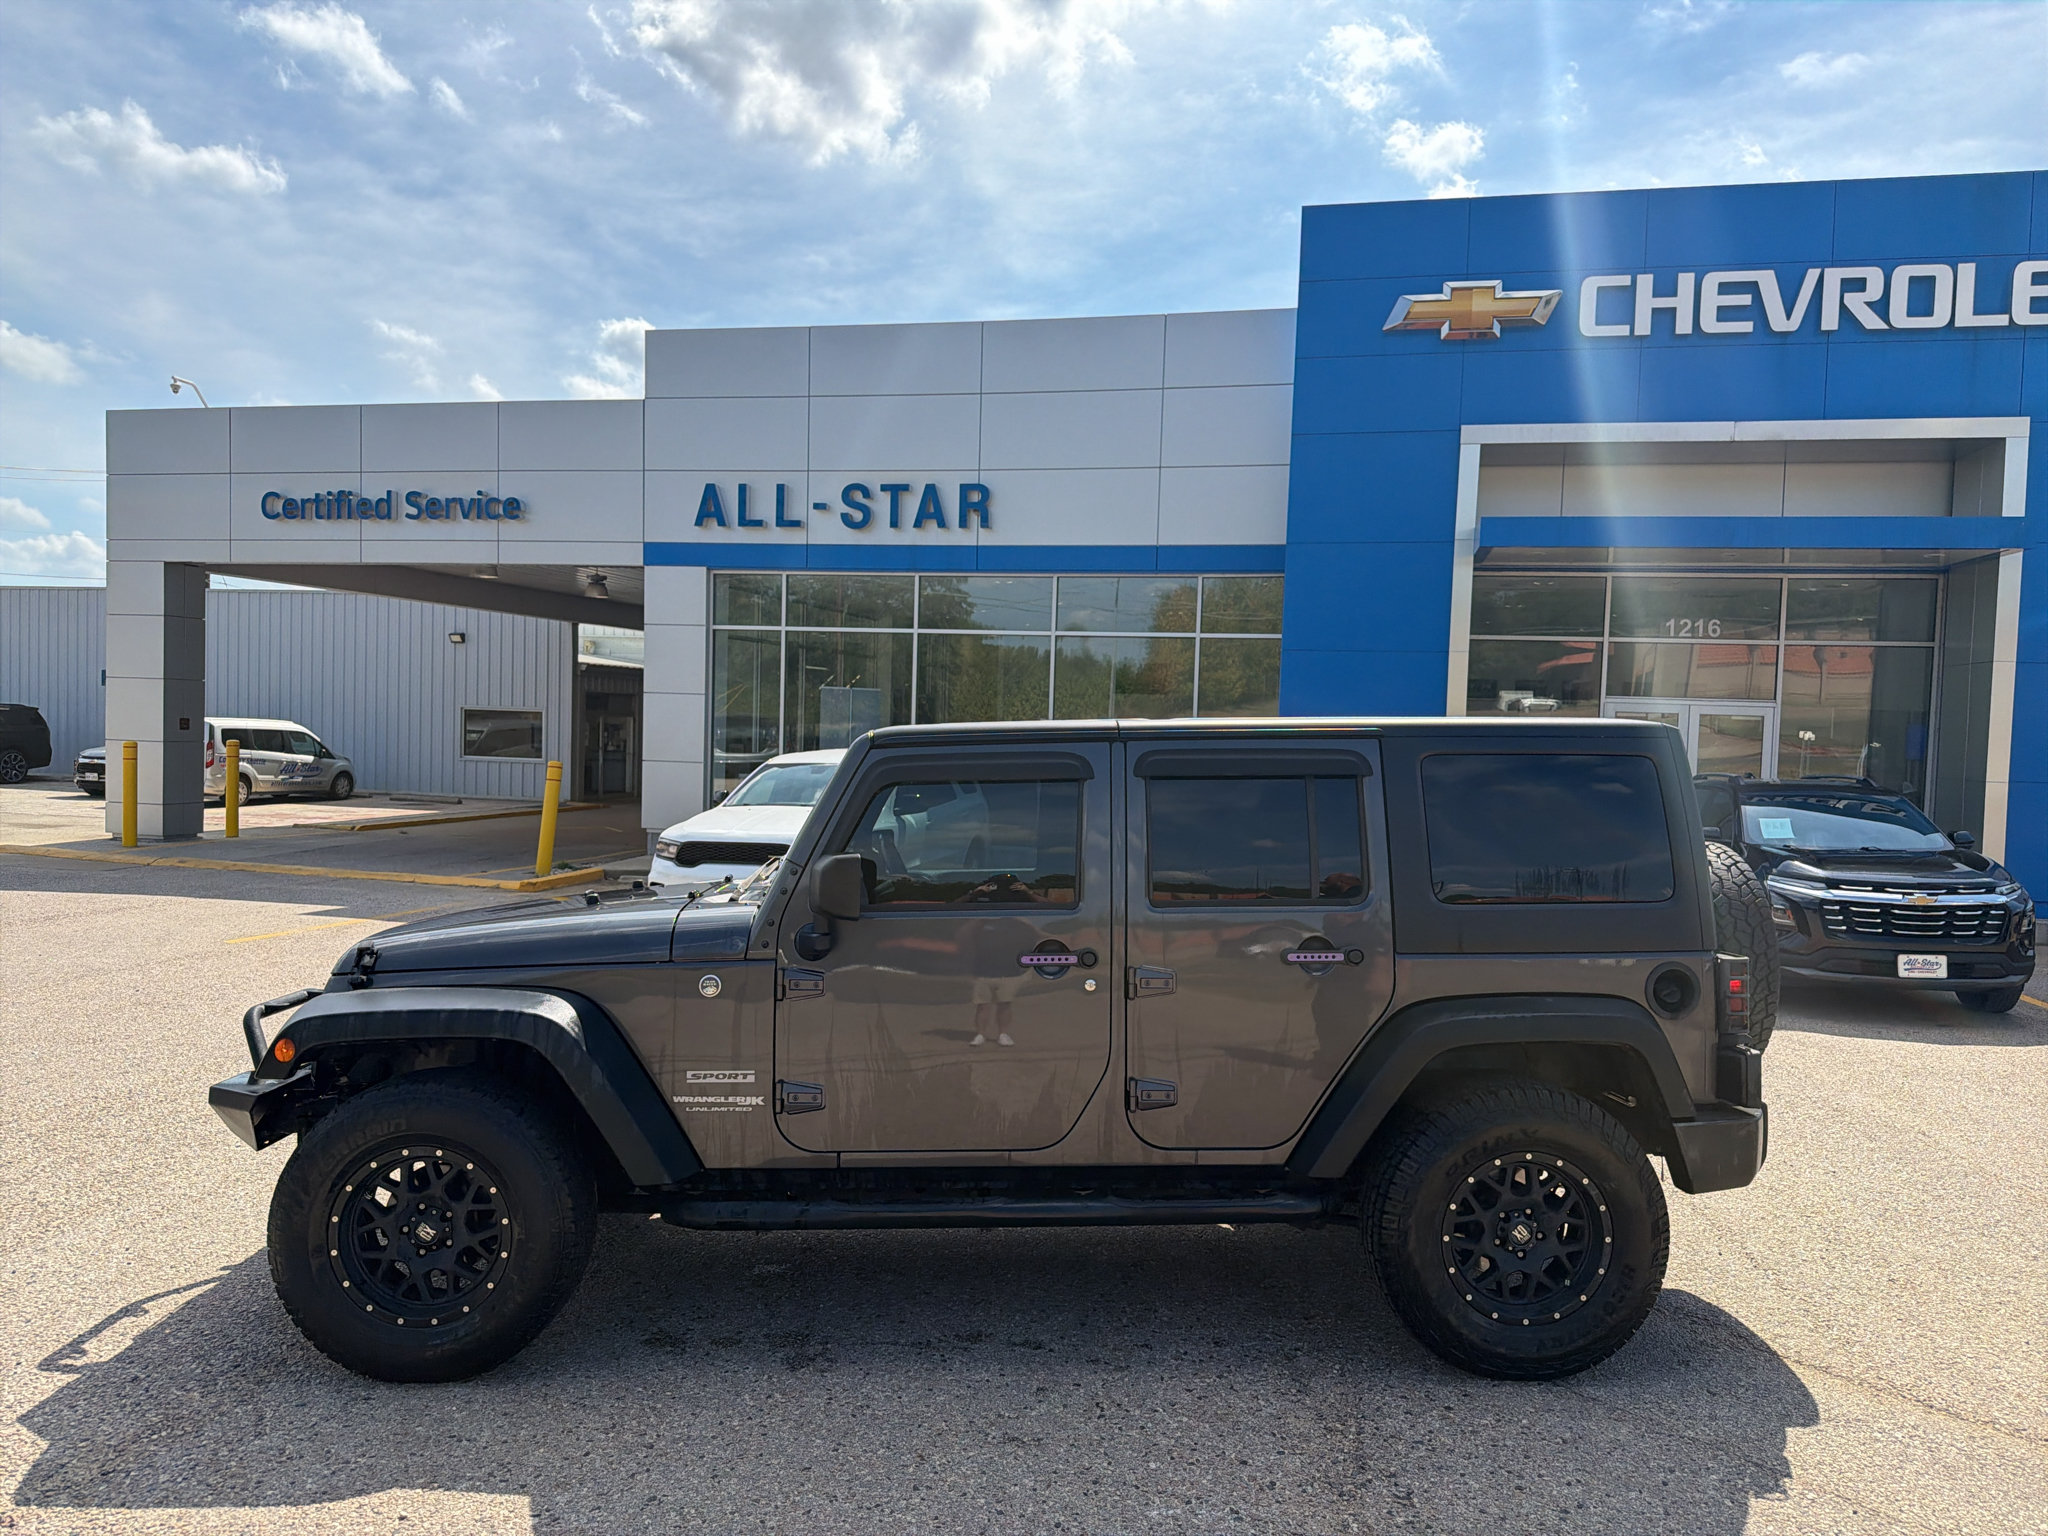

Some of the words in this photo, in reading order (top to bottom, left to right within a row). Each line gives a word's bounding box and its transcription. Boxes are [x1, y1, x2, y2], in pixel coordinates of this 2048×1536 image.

[261, 490, 391, 521] Certified
[404, 490, 522, 521] Service
[694, 482, 994, 530] ALL-STAR
[1666, 617, 1721, 638] 1216
[687, 1071, 756, 1081] SPORT
